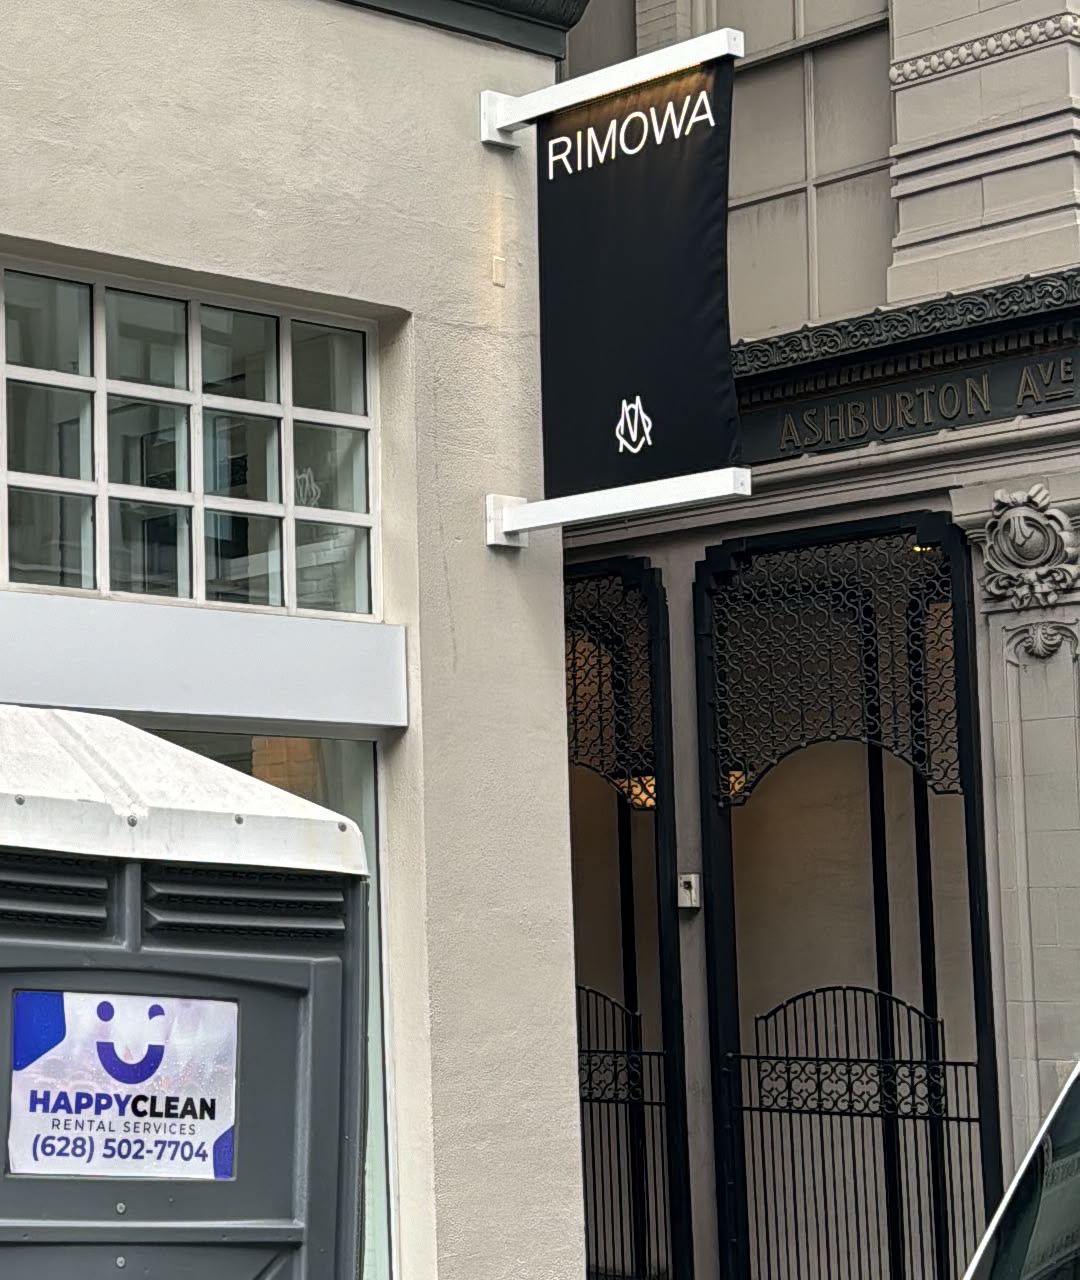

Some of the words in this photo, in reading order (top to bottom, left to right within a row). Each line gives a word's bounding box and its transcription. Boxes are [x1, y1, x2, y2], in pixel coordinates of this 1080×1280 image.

[548, 90, 716, 181] RIMOWA
[779, 372, 991, 450] ASHBURTON
[28, 1089, 216, 1120] HAPPYCLEAN
[51, 1117, 116, 1133] RENTAL
[122, 1121, 196, 1136] SERVICES
[31, 1133, 95, 1164] (628)
[102, 1138, 209, 1163] 502-7704
